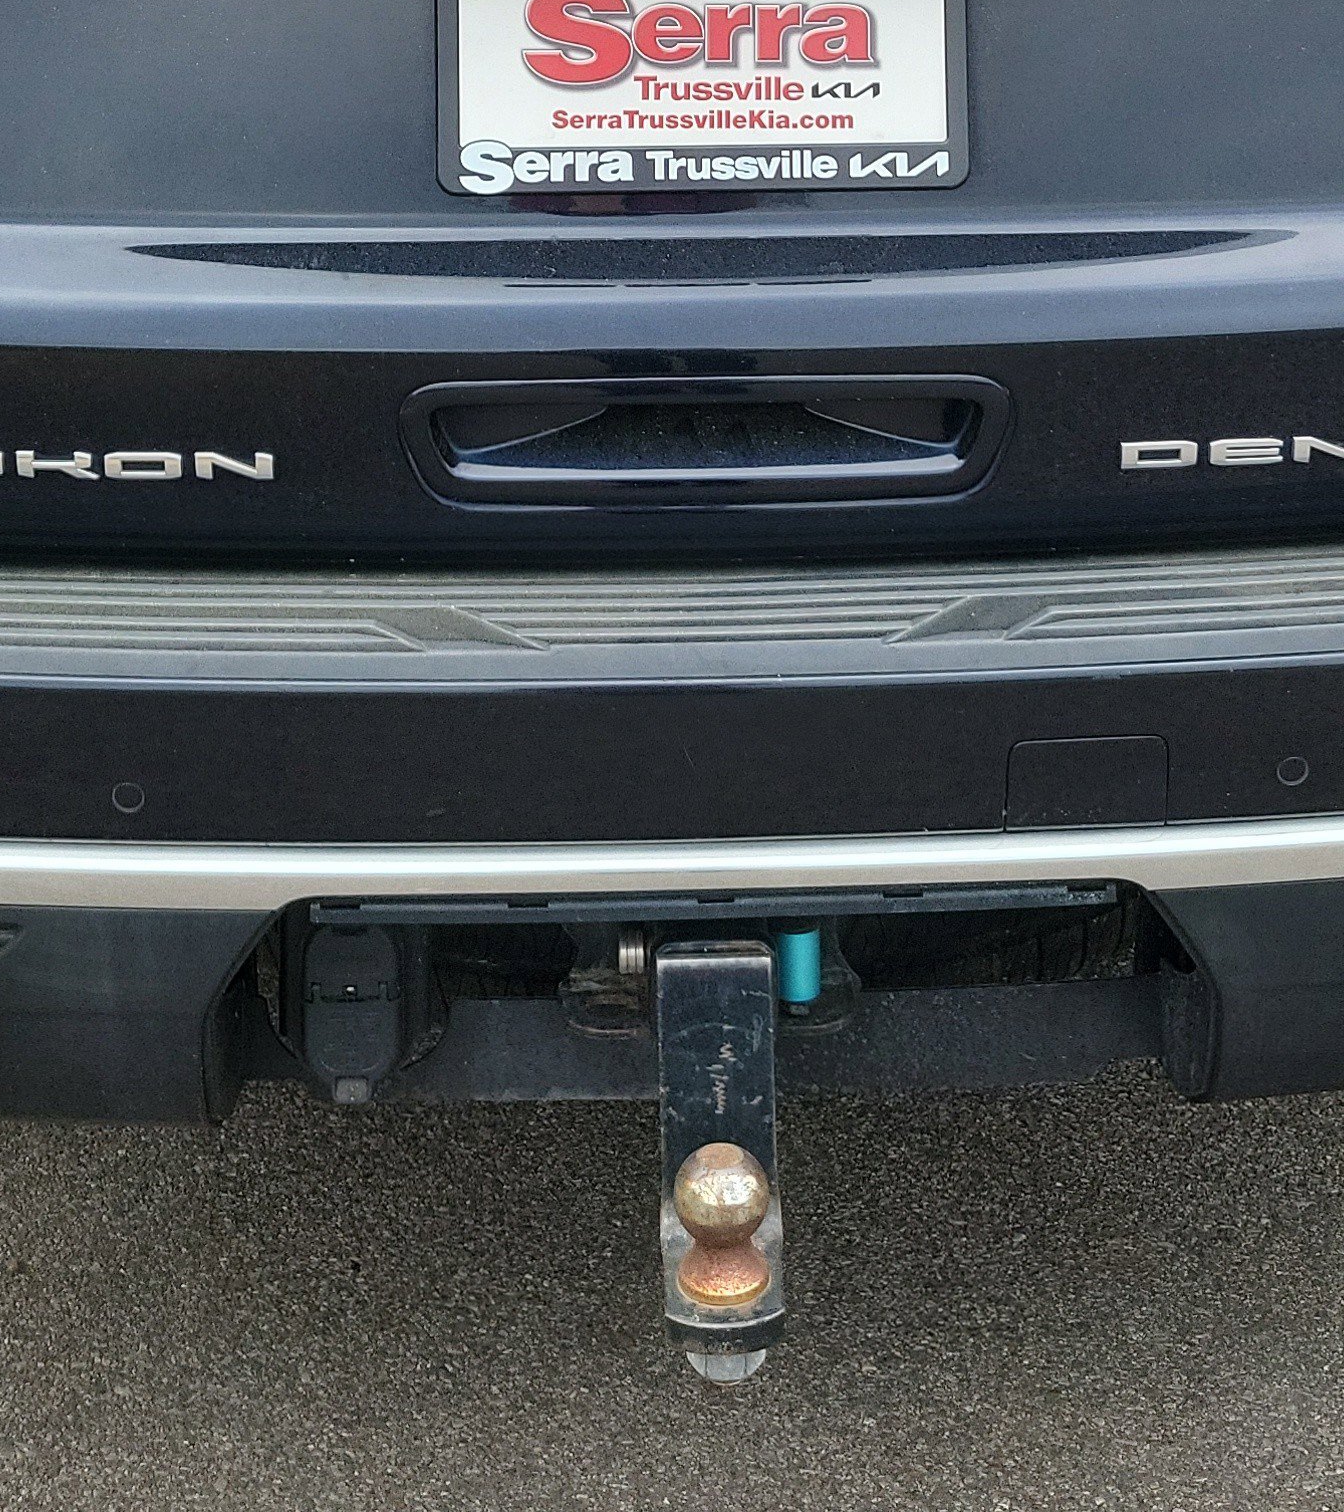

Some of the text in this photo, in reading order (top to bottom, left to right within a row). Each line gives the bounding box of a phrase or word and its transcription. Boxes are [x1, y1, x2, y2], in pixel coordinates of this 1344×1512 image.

[633, 76, 881, 101] Trussville KIA
[551, 109, 854, 131] SerraTrussvilleKia.com
[458, 140, 950, 195] Serra Trussville KIA
